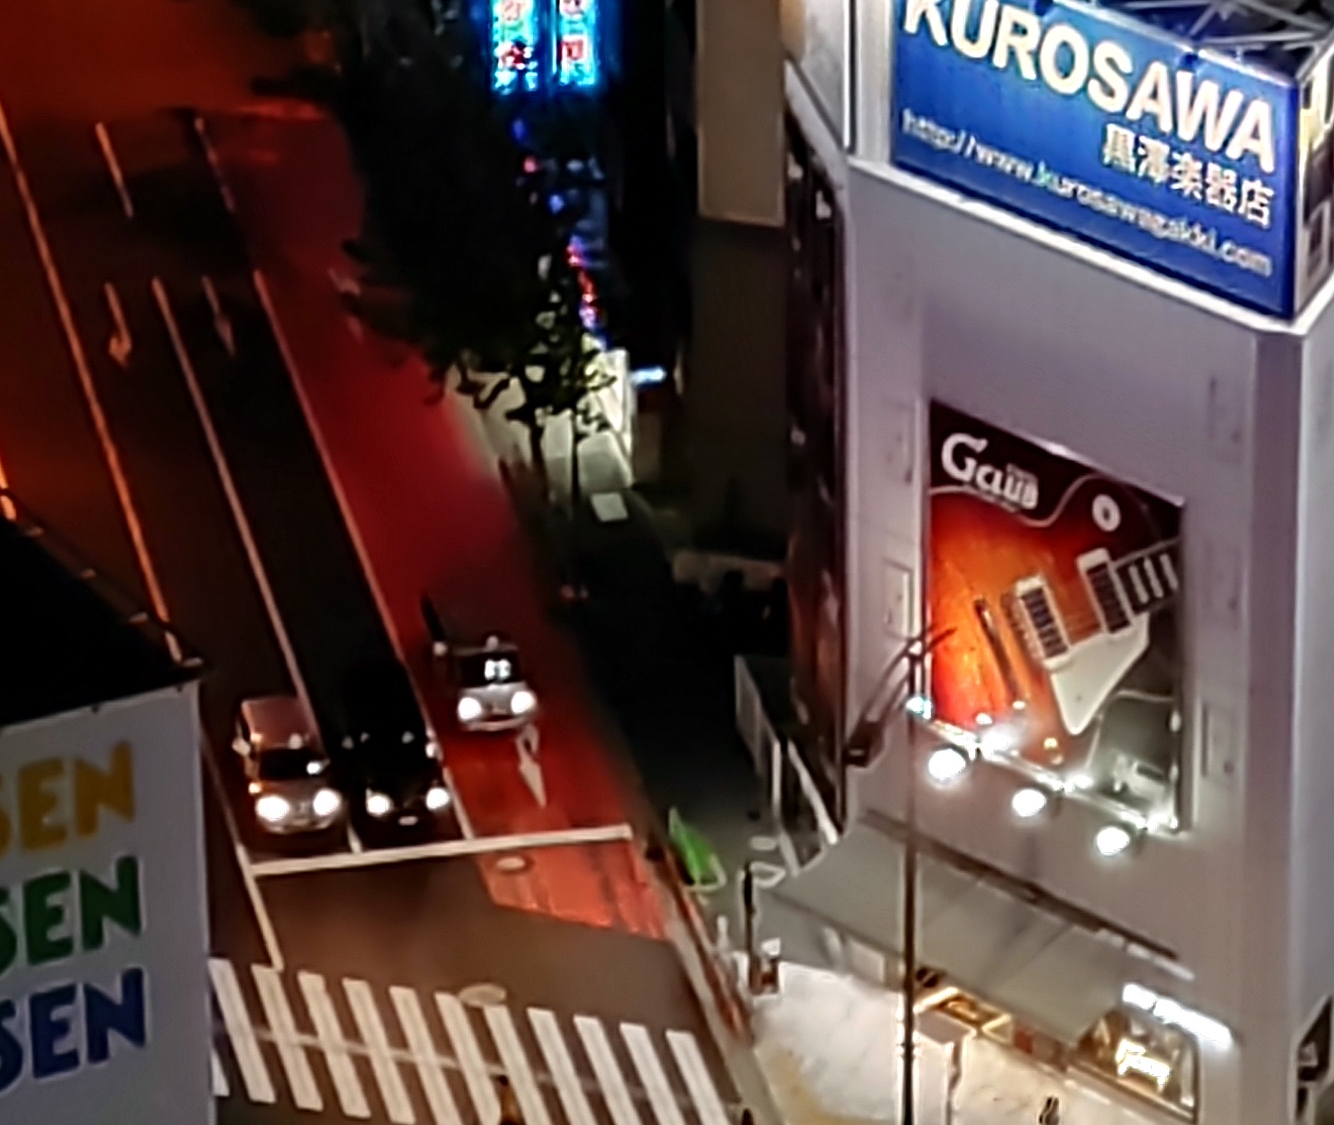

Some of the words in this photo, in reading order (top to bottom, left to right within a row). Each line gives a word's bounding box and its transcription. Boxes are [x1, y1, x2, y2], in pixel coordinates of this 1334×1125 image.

[903, 0, 1276, 172] KUROSAWA
[1101, 122, 1276, 229] 黒澤楽器店
